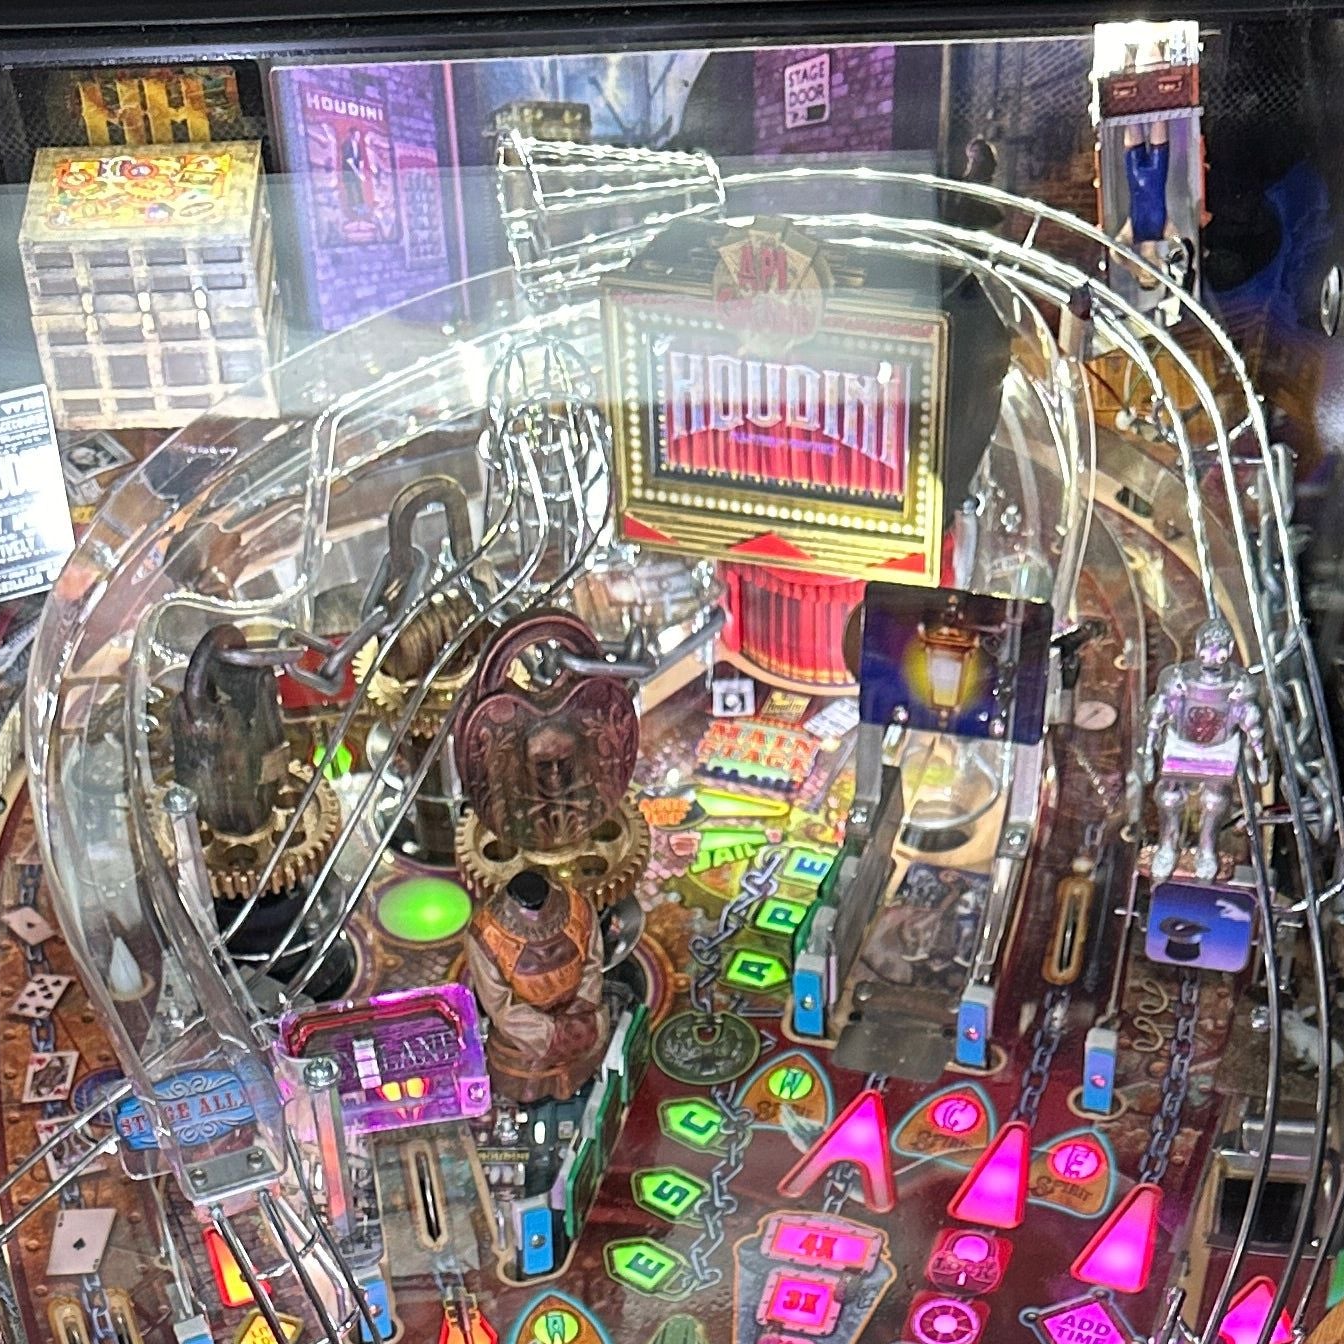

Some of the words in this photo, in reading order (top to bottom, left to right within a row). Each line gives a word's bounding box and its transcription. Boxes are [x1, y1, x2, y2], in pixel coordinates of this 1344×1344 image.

[788, 60, 826, 88] STAGE
[306, 91, 385, 122] HOUDINI
[788, 83, 826, 108] DOOR
[668, 351, 904, 471] HOUDINI
[709, 719, 818, 755] MAIN
[689, 841, 757, 875] JAIL
[119, 1101, 192, 1137] STGE
[1031, 1175, 1094, 1203] SPIRIT
[798, 1233, 838, 1260] 4X
[782, 1289, 822, 1316] 3X
[1060, 1313, 1112, 1337] ADD
